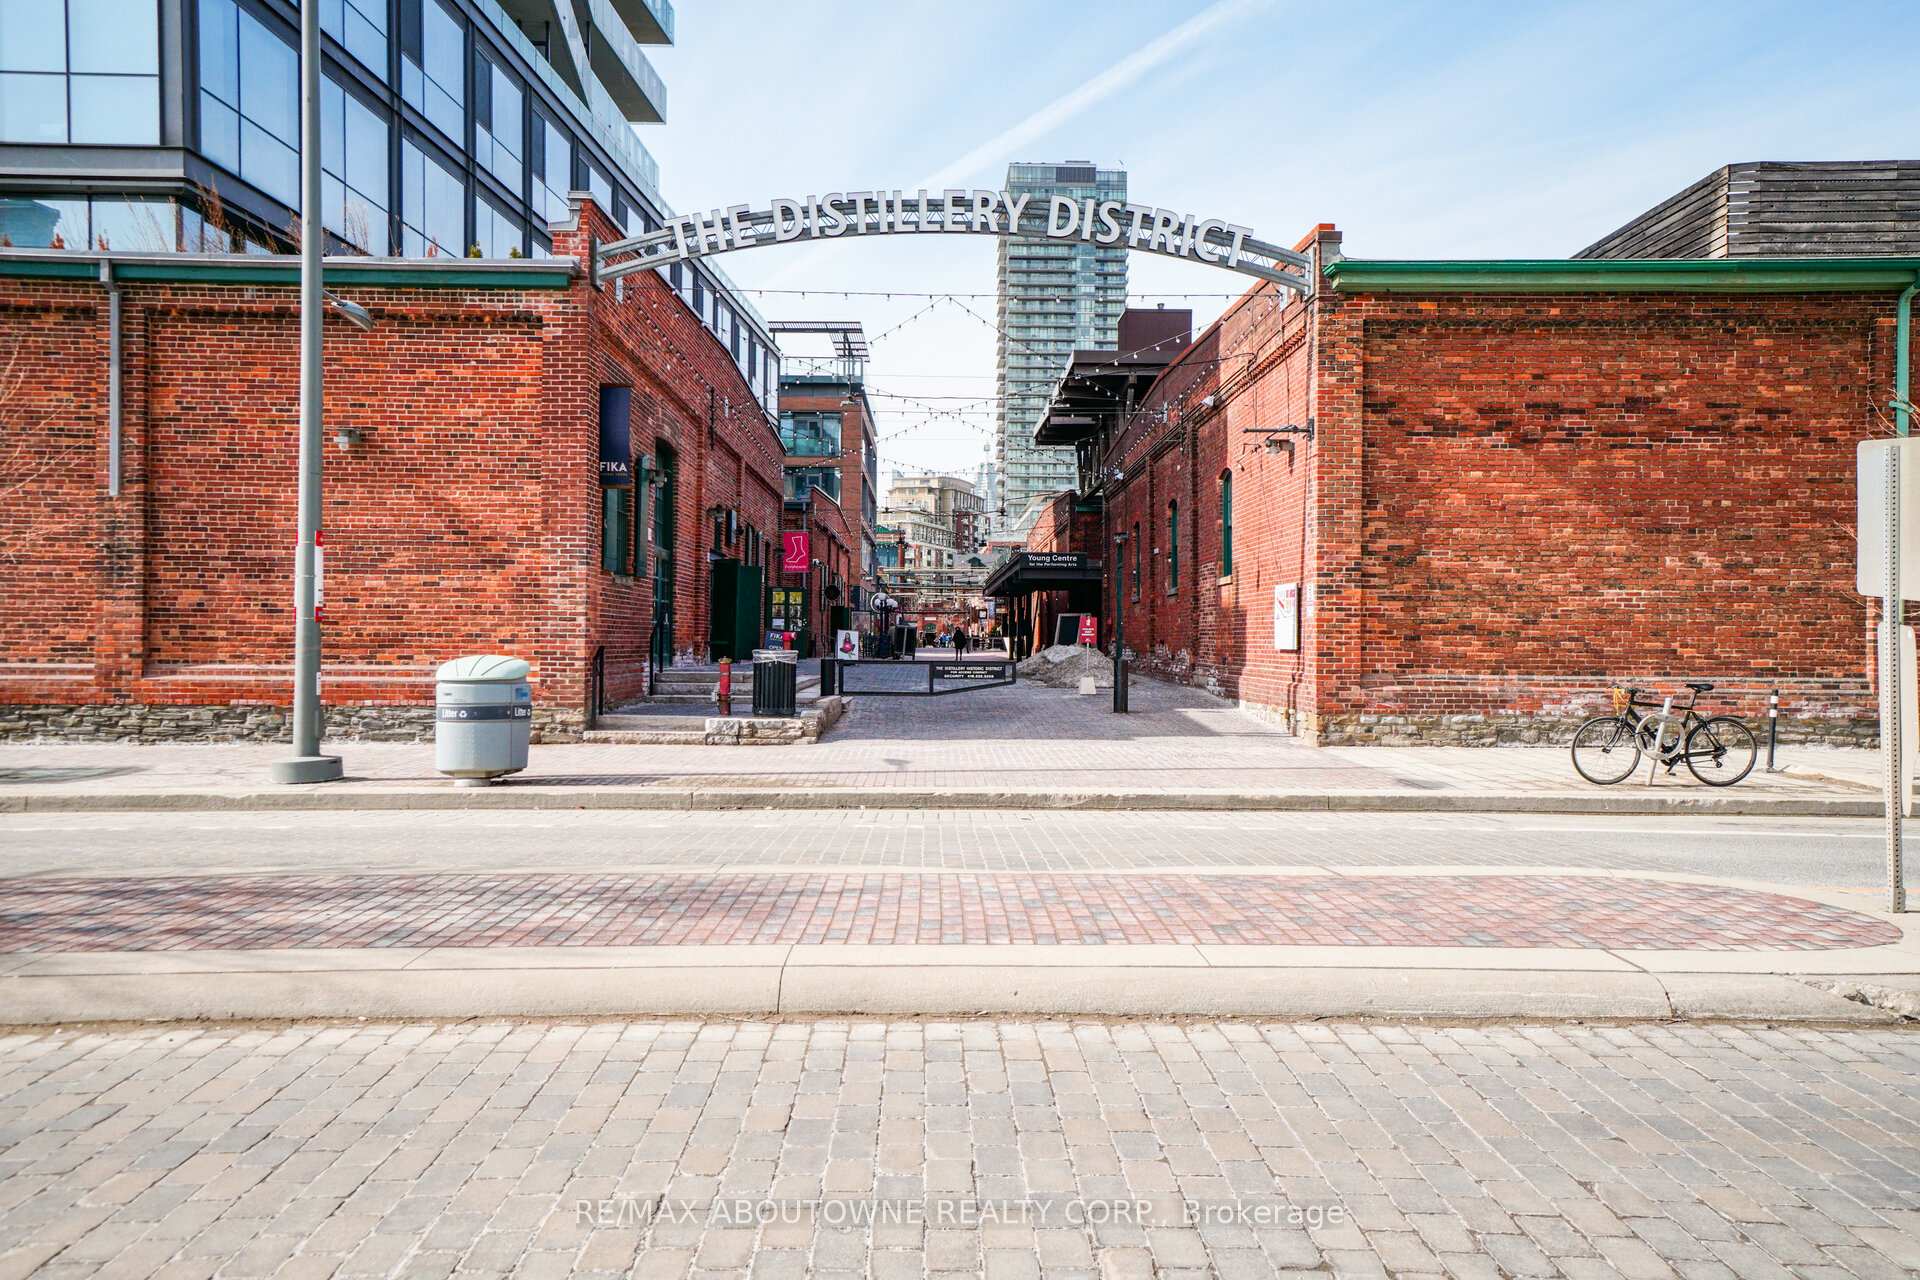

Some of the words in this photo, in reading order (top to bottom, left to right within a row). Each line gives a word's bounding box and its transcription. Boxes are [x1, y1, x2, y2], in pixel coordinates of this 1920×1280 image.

[664, 204, 757, 259] THE
[771, 187, 1030, 242] DISTILLERY
[1047, 194, 1254, 268] DISTRICT
[600, 461, 628, 472] FIKA
[1028, 554, 1051, 562] Young
[1052, 554, 1078, 562] Centre
[441, 708, 458, 718] Litter
